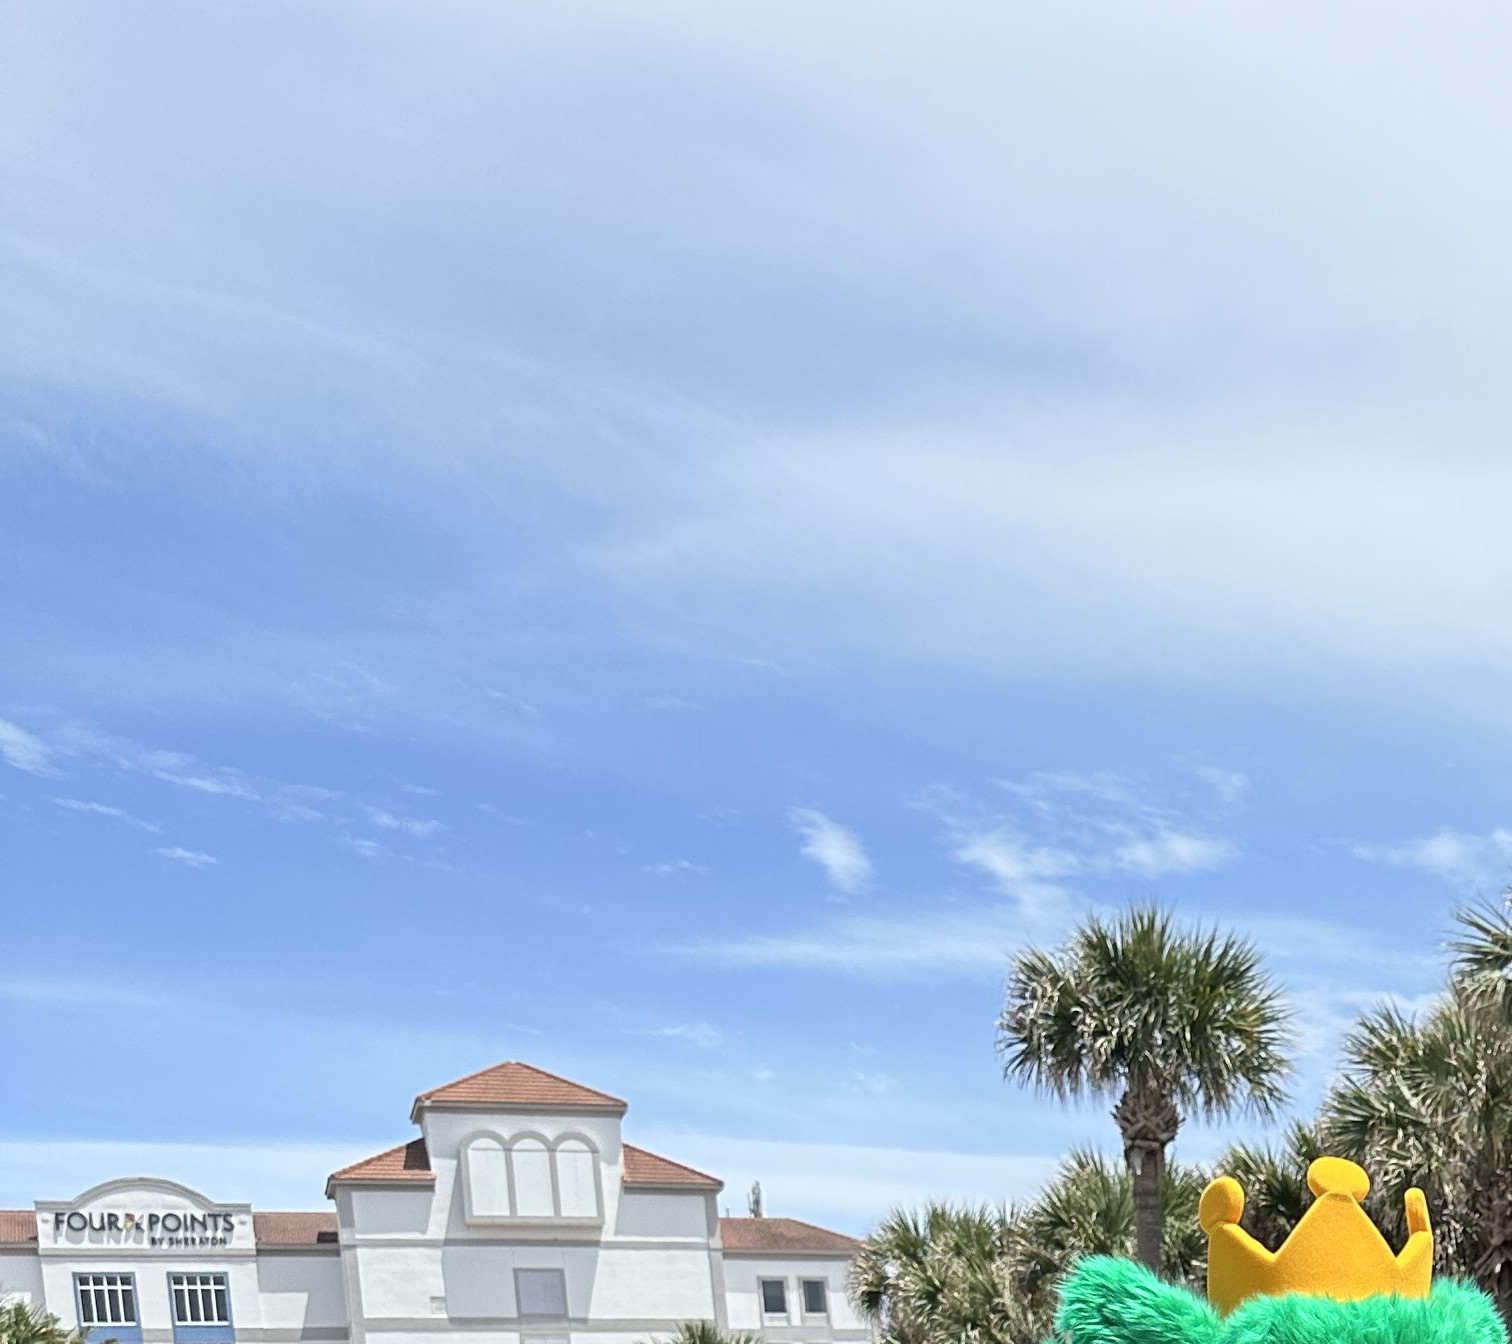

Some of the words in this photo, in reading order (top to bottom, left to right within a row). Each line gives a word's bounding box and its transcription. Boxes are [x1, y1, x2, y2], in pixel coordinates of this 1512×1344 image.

[54, 1212, 122, 1232] FOUR
[149, 1212, 235, 1232] POINTS
[151, 1237, 163, 1246] BY
[168, 1237, 228, 1246] SHERATON
